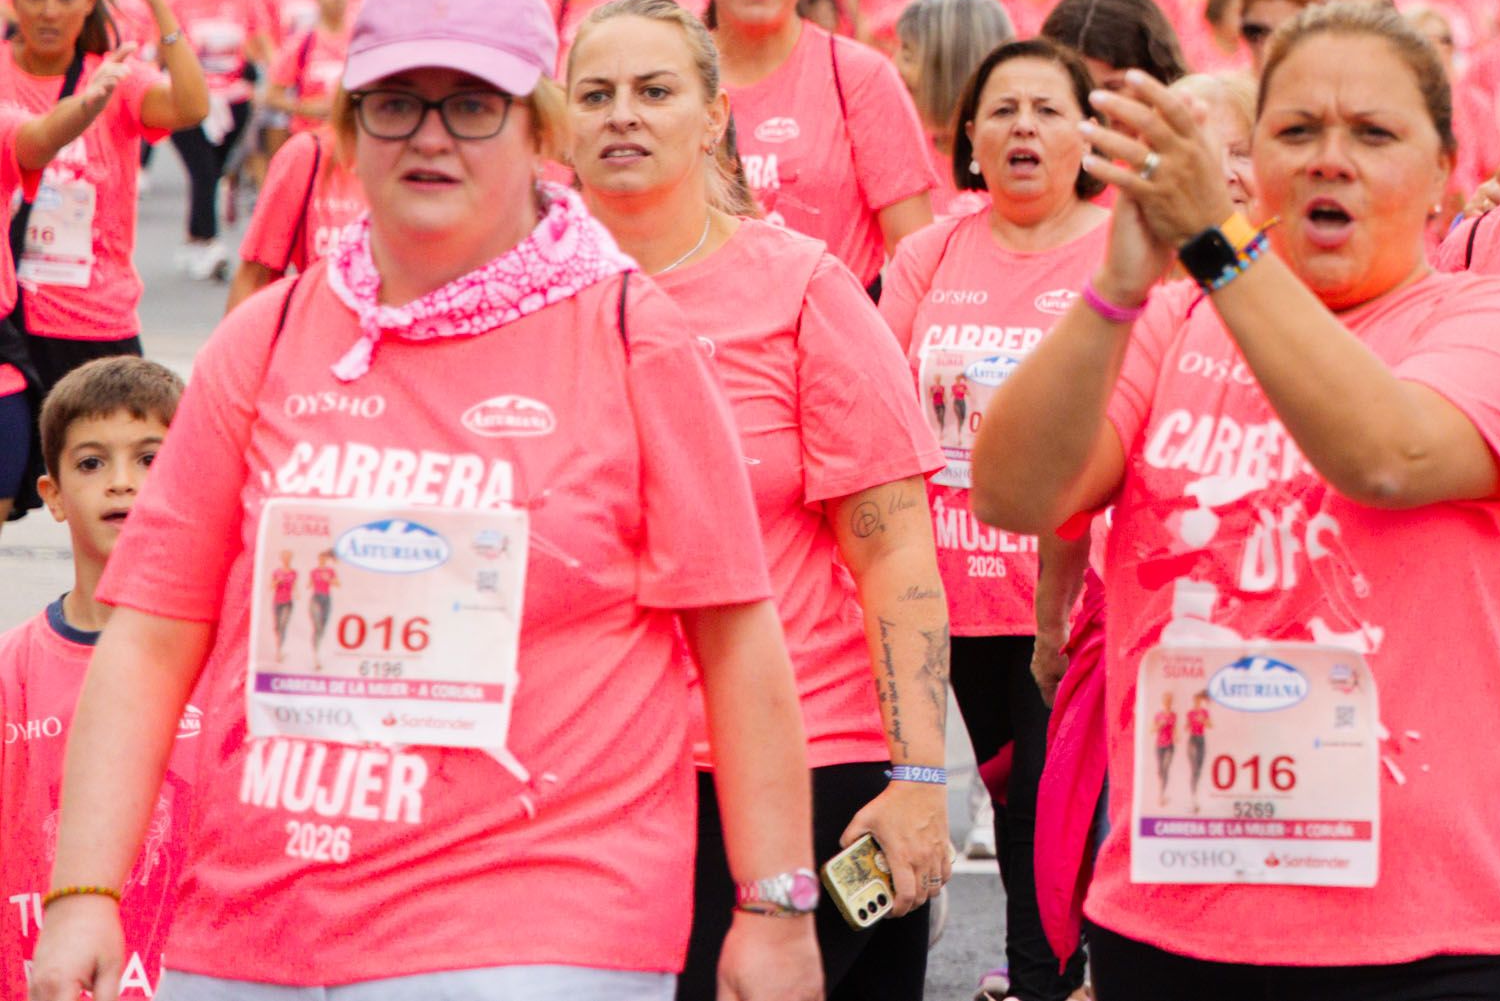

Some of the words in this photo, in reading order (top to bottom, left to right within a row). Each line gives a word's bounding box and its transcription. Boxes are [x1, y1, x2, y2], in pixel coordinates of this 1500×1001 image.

[30, 226, 55, 244] 16
[932, 289, 988, 305] OYSHO
[926, 324, 1043, 354] CARRER
[284, 392, 386, 418] OYSHO
[471, 410, 546, 429] ASTURIANA
[275, 440, 514, 511] CARRERA
[346, 538, 442, 561] ASTURIANA
[967, 555, 1007, 578] 2026
[337, 614, 430, 652] 016
[359, 661, 402, 677] 6196
[270, 678, 327, 693] CARRERA
[329, 680, 346, 694] DE
[349, 681, 365, 695] LA
[367, 682, 409, 697] MUJER
[1216, 677, 1300, 697] ASTURIANA
[276, 707, 352, 727] OYSHO
[401, 714, 475, 730] Santander
[239, 738, 428, 824] MUJER
[1212, 754, 1296, 792] 016
[1233, 802, 1275, 818] 5269
[1154, 821, 1206, 836] CARRERA
[1208, 822, 1224, 836] DE
[1226, 822, 1243, 837] LA
[285, 820, 350, 863] 2026
[1160, 850, 1236, 868] OYSHO
[1282, 854, 1351, 869] Santander
